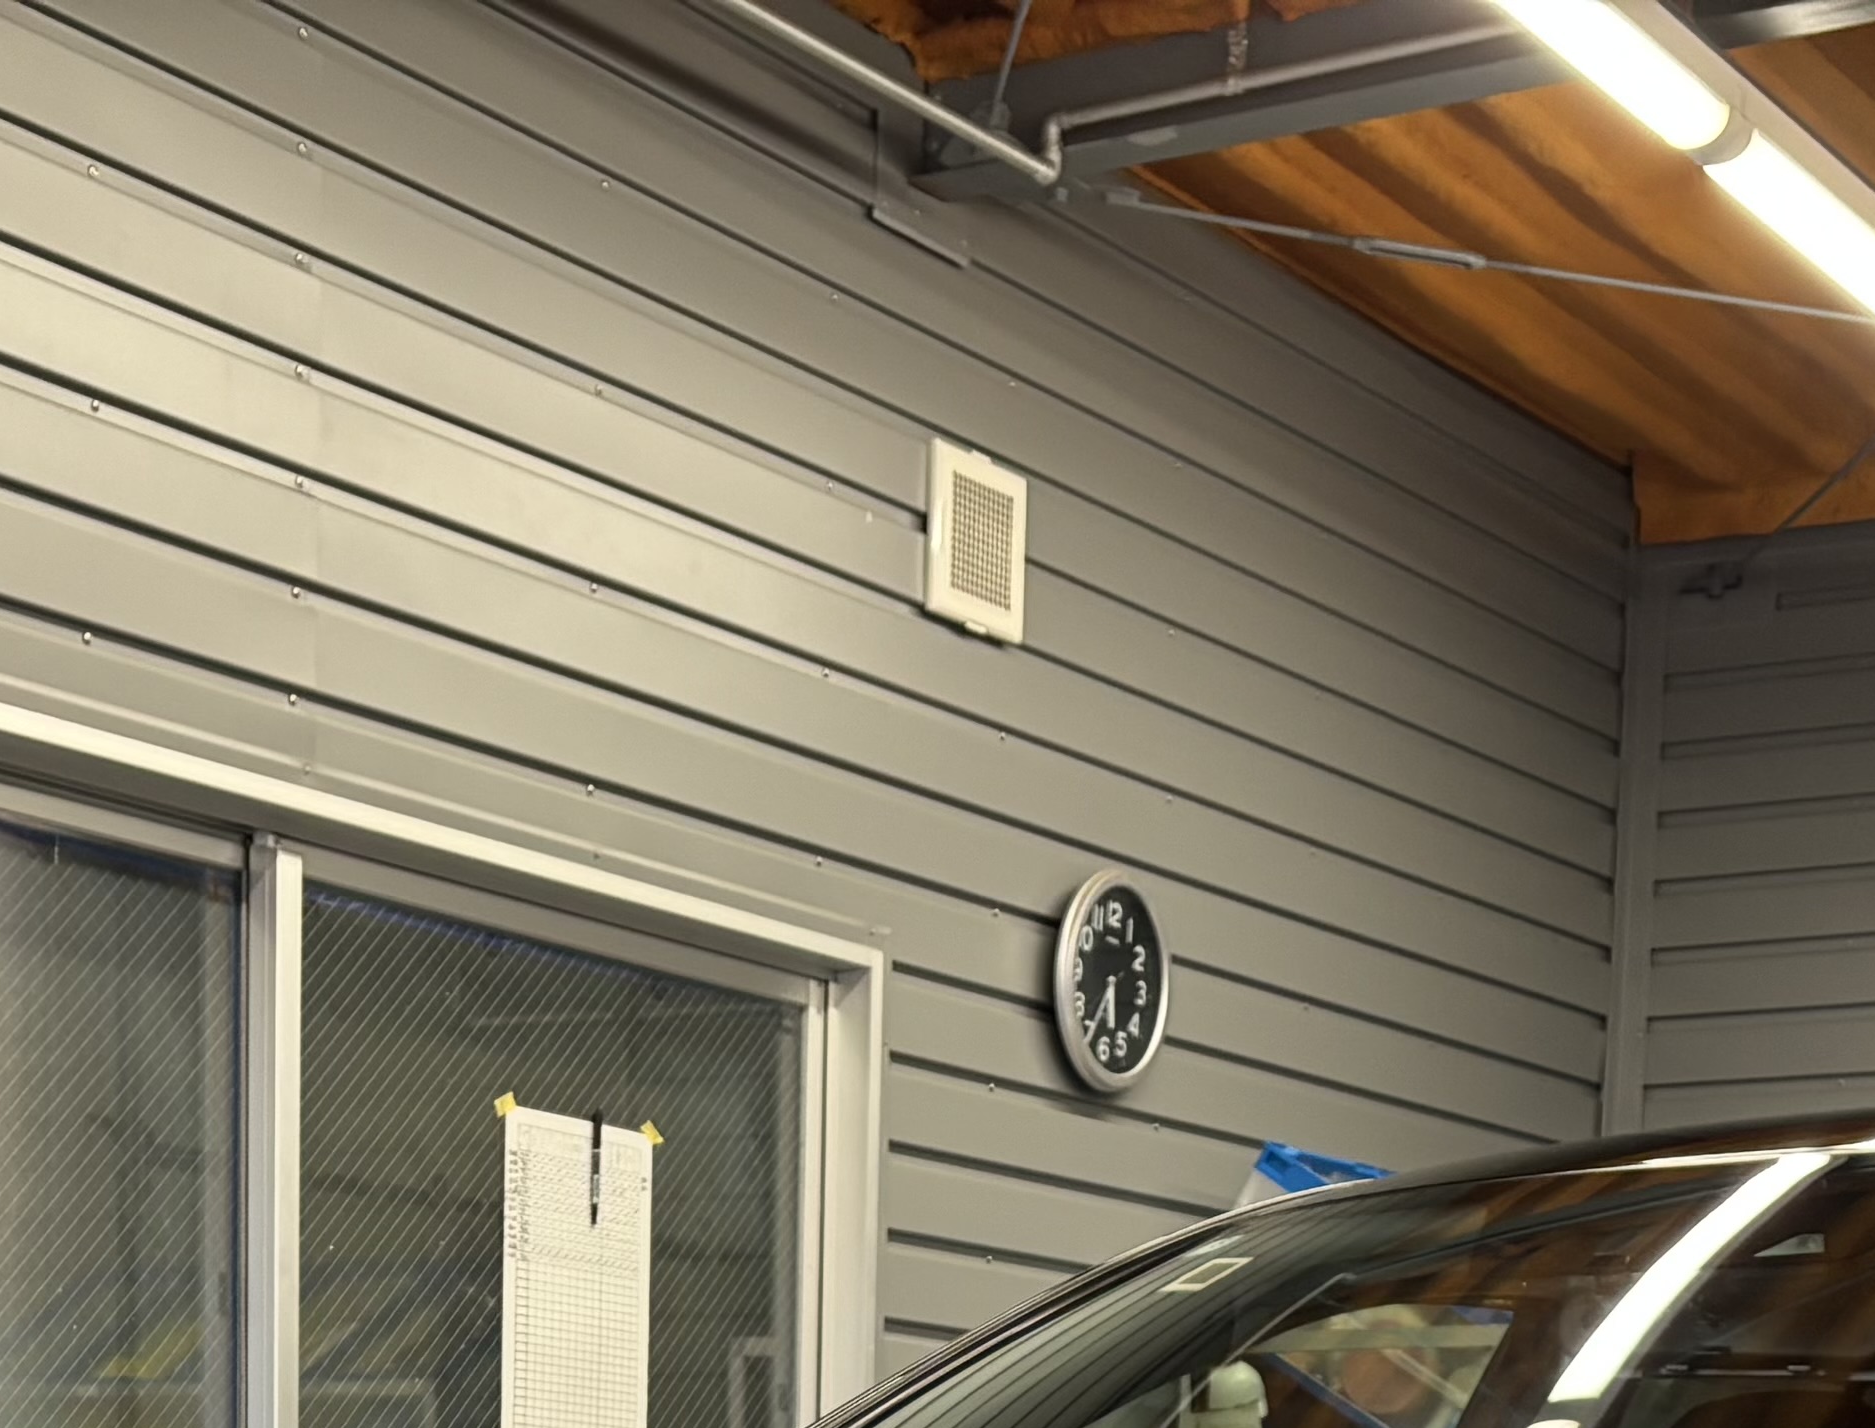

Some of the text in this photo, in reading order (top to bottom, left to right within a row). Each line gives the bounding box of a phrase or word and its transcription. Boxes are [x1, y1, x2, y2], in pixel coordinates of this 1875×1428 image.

[1105, 900, 1123, 929] 12
[1125, 917, 1134, 944] 1
[1131, 945, 1146, 972] 2
[1133, 980, 1147, 1008] 3
[1126, 1012, 1140, 1038] 4
[1096, 1036, 1111, 1062] 6
[1113, 1031, 1127, 1058] 5
